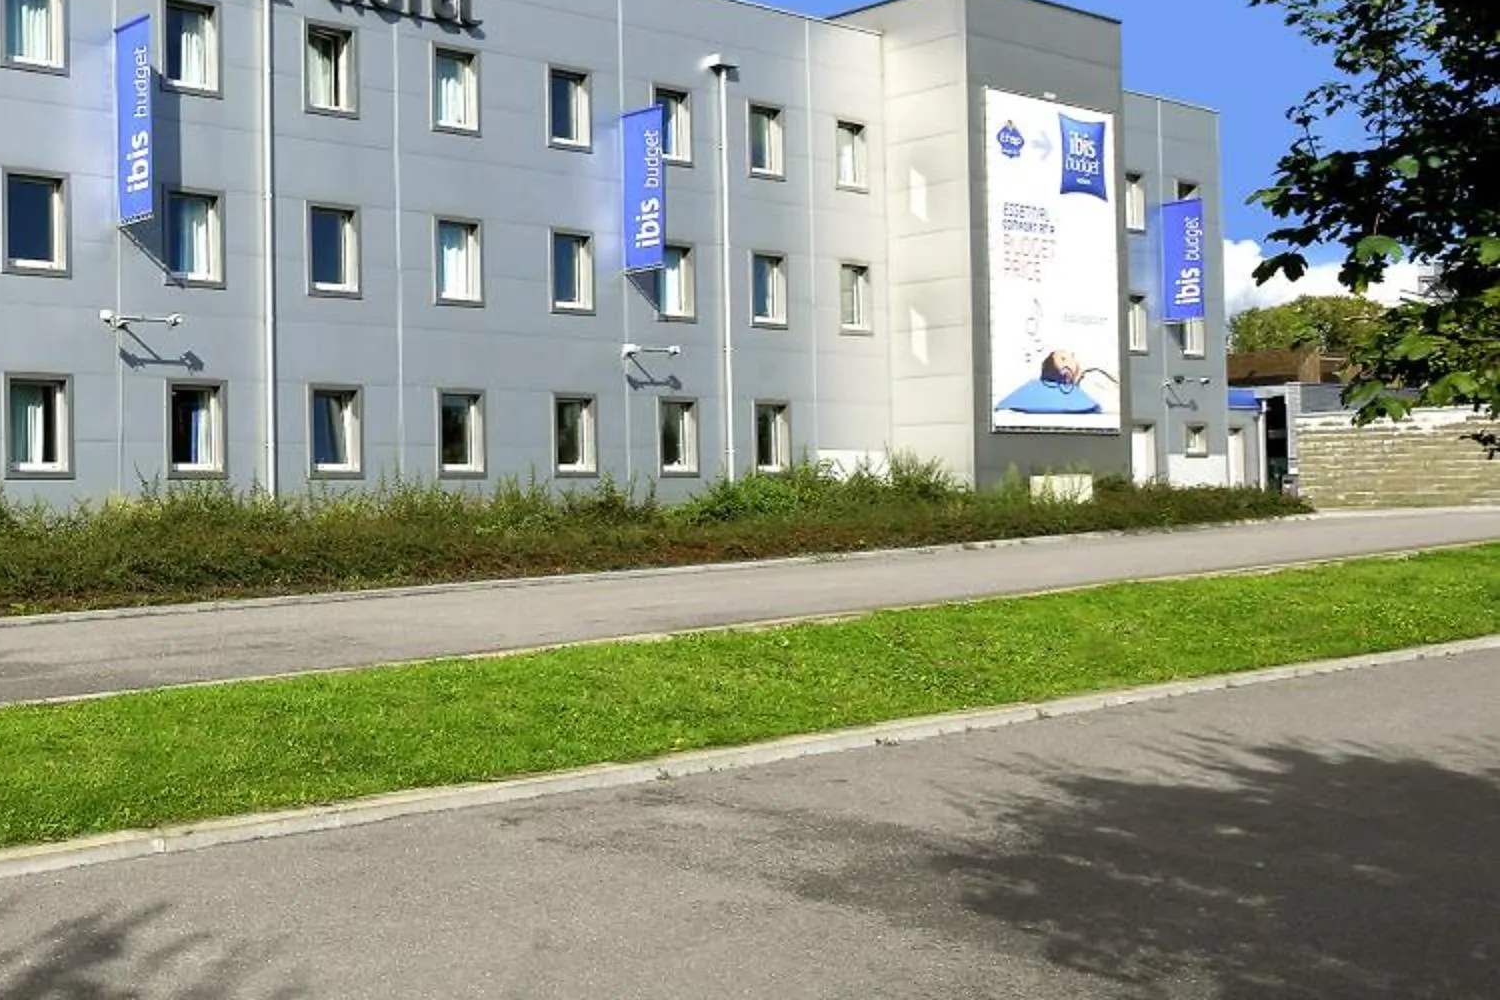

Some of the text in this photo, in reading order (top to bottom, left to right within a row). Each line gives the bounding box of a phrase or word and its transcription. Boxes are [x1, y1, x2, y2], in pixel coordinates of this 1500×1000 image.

[127, 45, 151, 192] ibis budget
[1069, 130, 1096, 158] ibis
[635, 130, 662, 248] ibis budget
[1175, 215, 1202, 305] ibis budget
